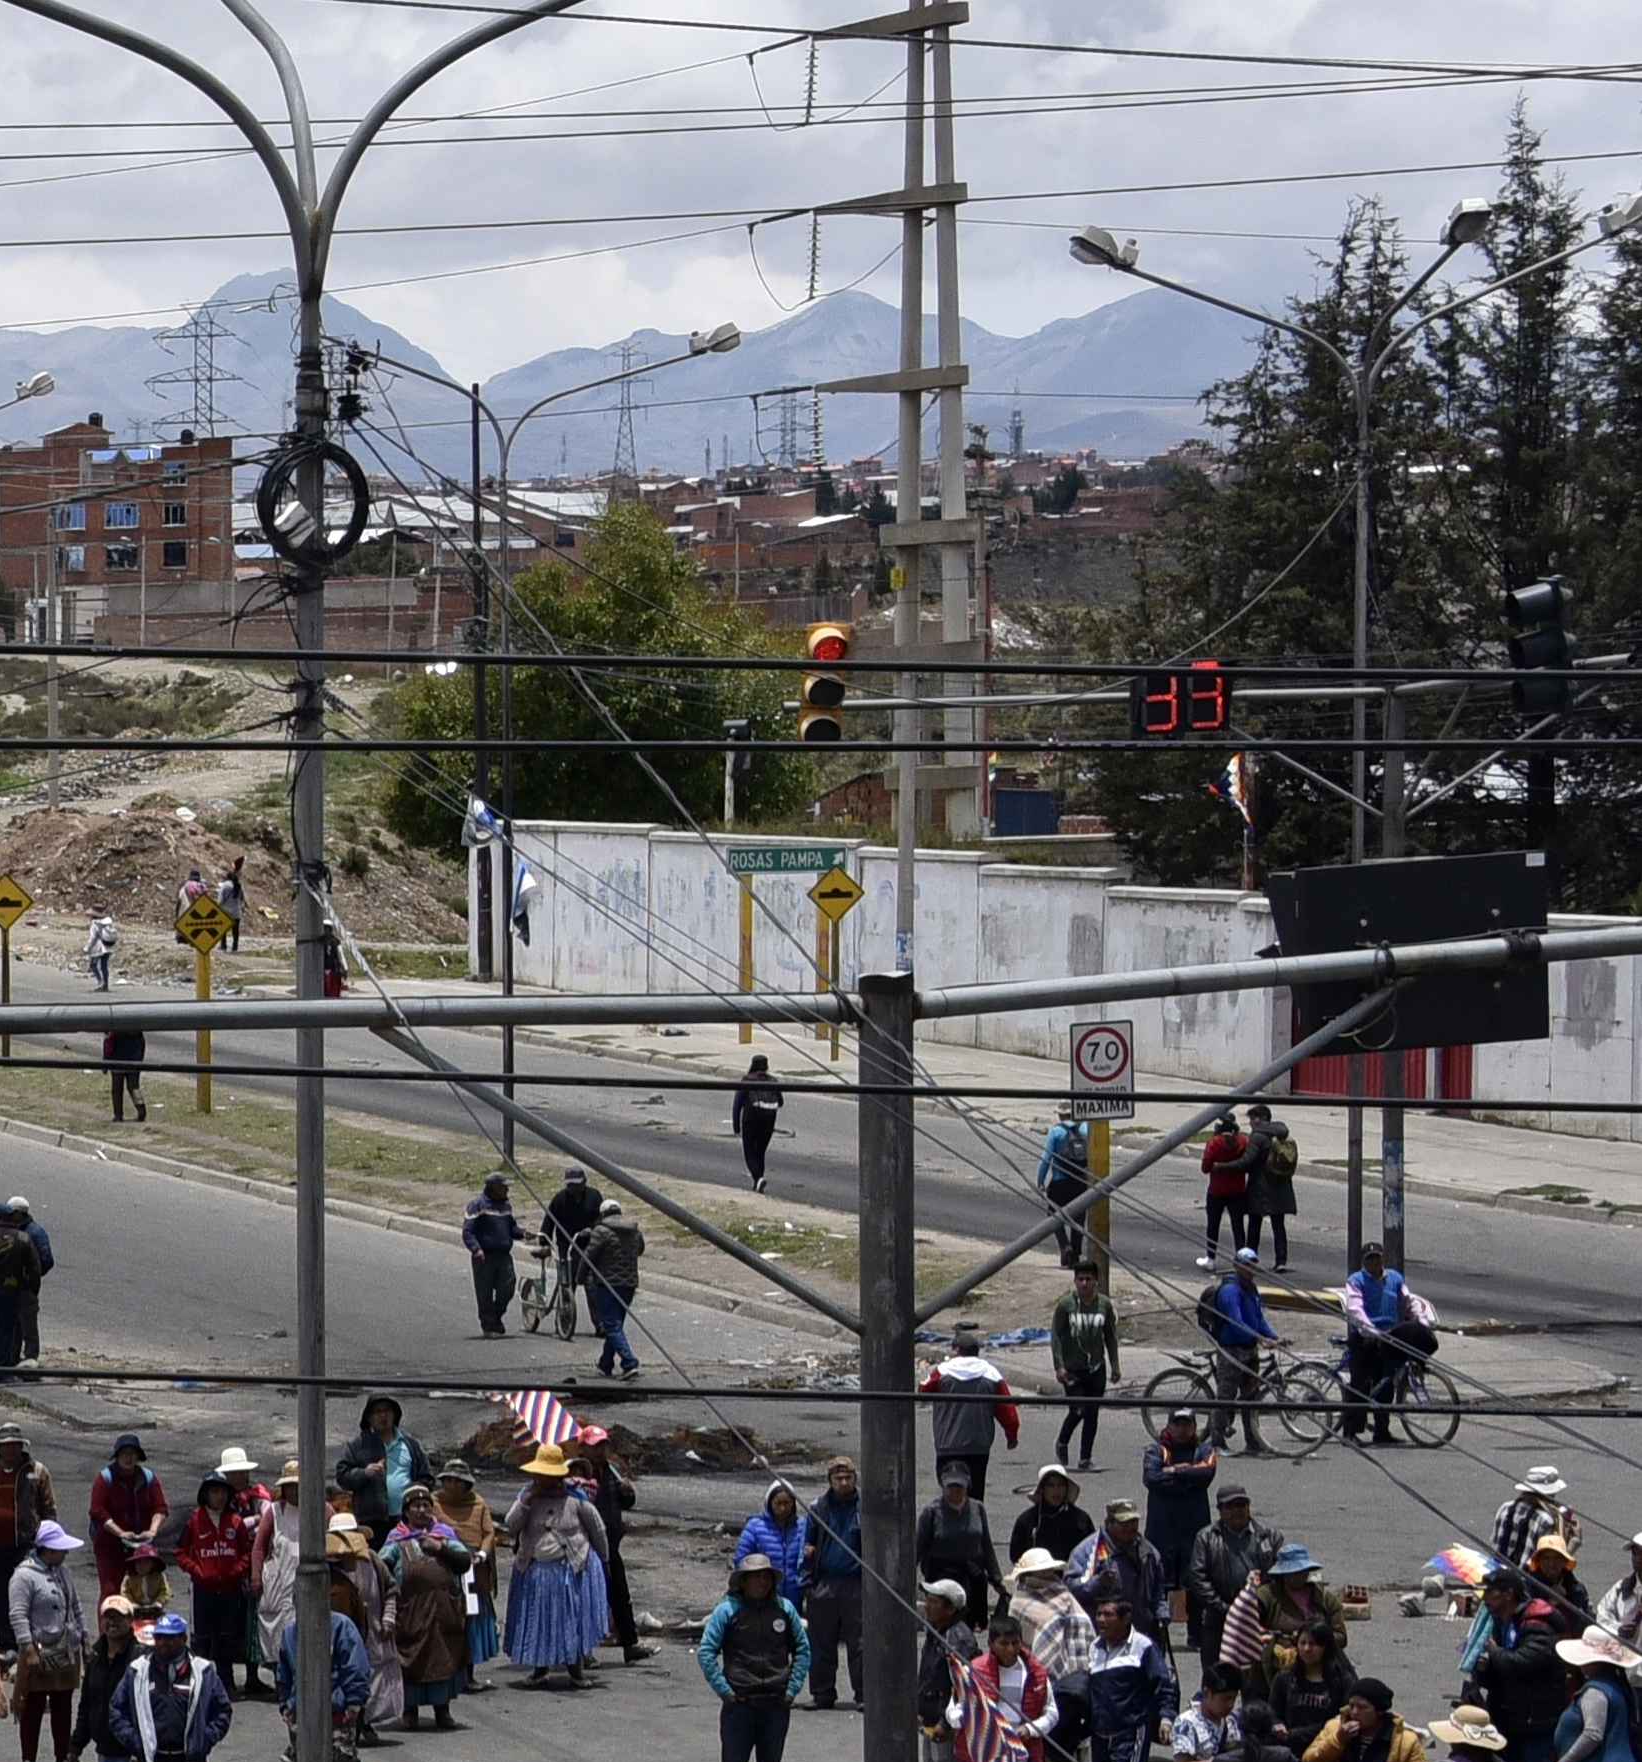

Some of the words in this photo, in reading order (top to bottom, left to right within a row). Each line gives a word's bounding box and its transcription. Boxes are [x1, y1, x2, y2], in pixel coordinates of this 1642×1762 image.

[1146, 660, 1224, 731] 33
[730, 852, 773, 869] ROSAS
[781, 851, 824, 868] PAMPA
[1087, 1041, 1119, 1063] 70
[1076, 1101, 1130, 1115] MAXIMA
